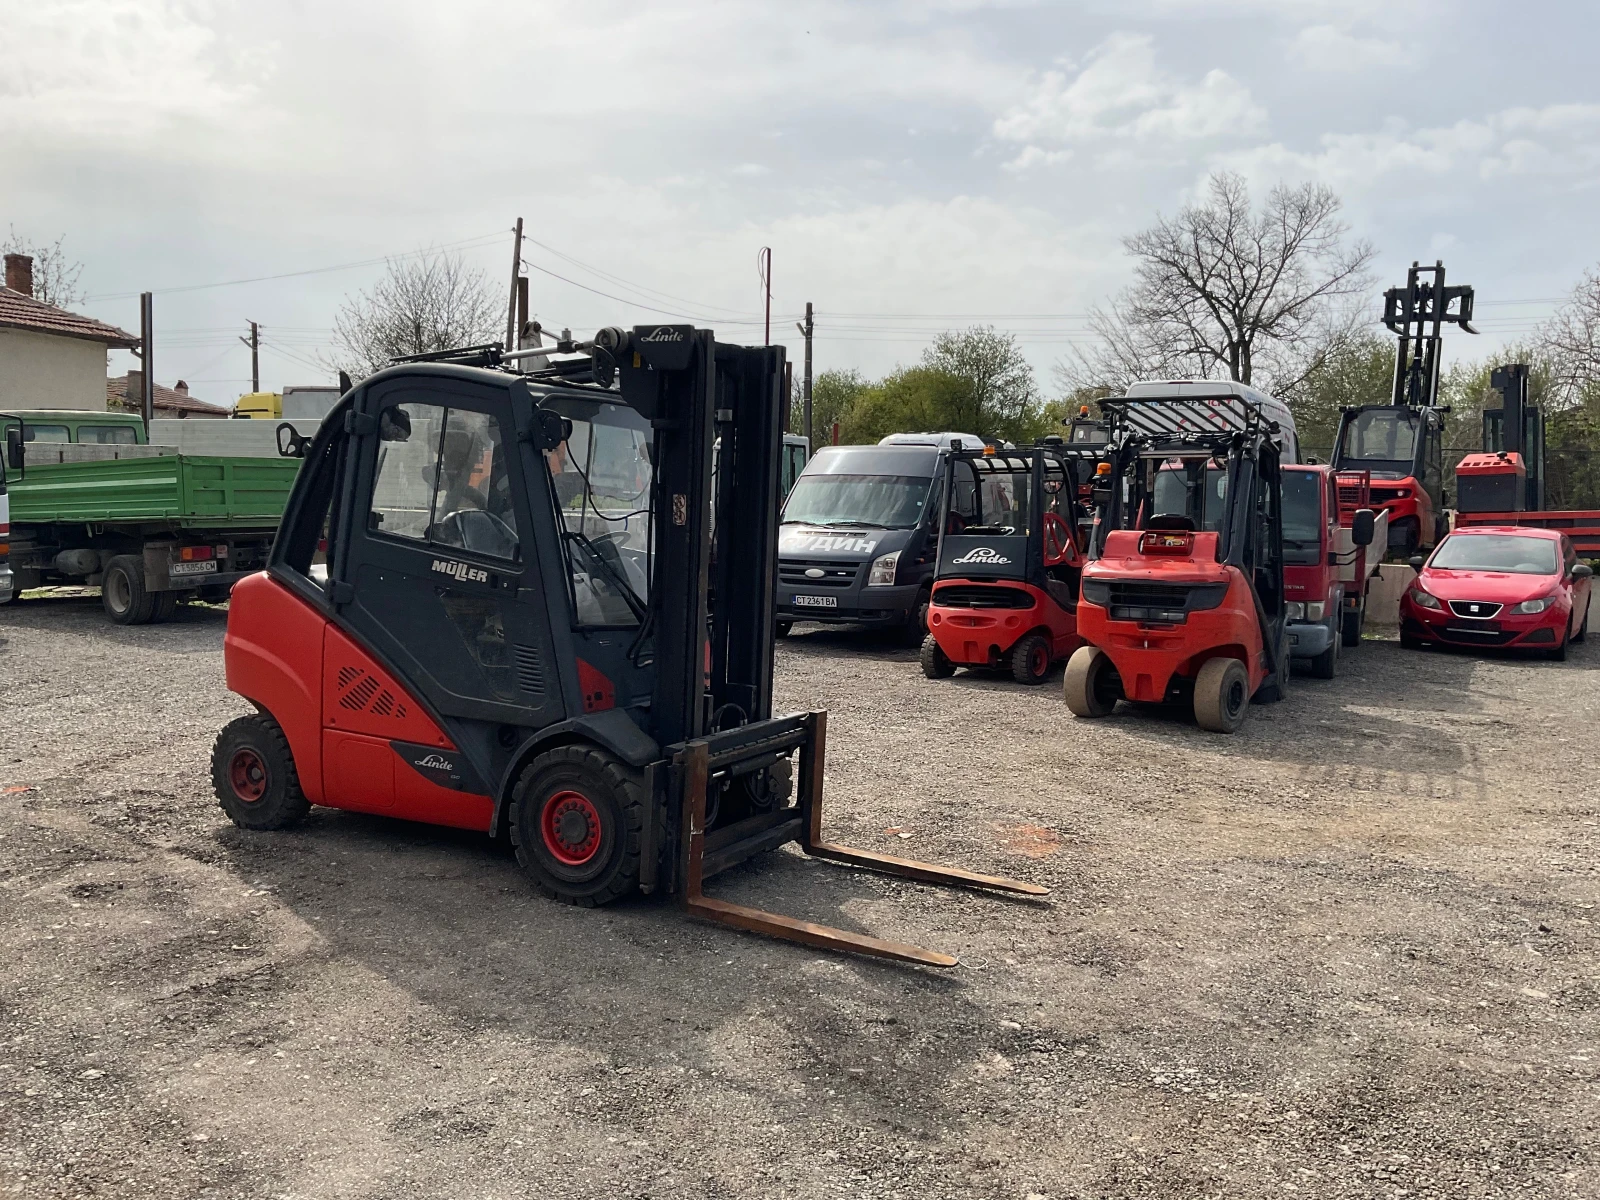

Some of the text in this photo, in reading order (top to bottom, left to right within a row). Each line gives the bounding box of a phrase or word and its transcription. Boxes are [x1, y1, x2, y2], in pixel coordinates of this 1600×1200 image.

[640, 326, 684, 342] Linde
[952, 547, 1012, 564] Linde
[414, 754, 453, 771] Linde
